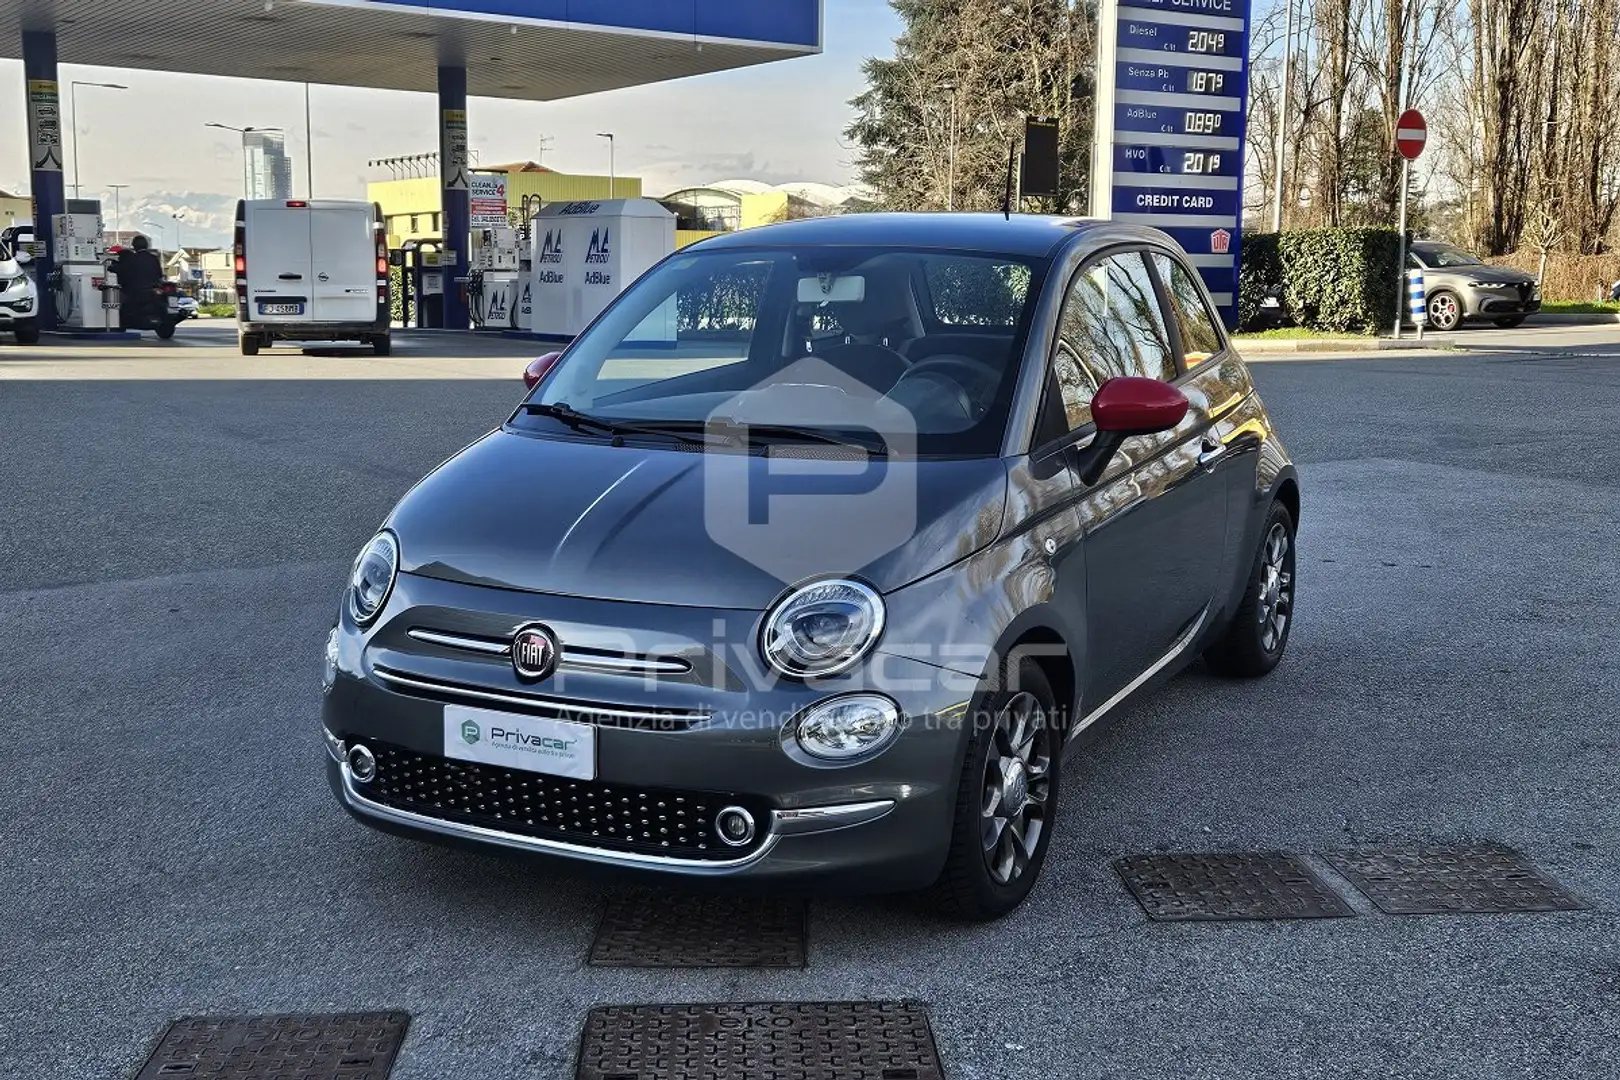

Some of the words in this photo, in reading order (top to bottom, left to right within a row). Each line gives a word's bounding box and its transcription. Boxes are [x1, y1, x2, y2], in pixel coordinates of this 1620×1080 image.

[1129, 24, 1157, 37] Diesel
[1128, 67, 1156, 78] Senza
[1158, 69, 1169, 78] Pb
[1127, 108, 1157, 119] AdBlue
[1125, 149, 1146, 160] HVO
[1136, 194, 1180, 207] CREDIT
[1182, 196, 1214, 208] CARD
[558, 201, 602, 215] AdBlue
[539, 271, 564, 284] AdBlue
[584, 271, 611, 284] AdBlue
[521, 642, 545, 666] FIAT
[491, 727, 578, 751] Privacar
